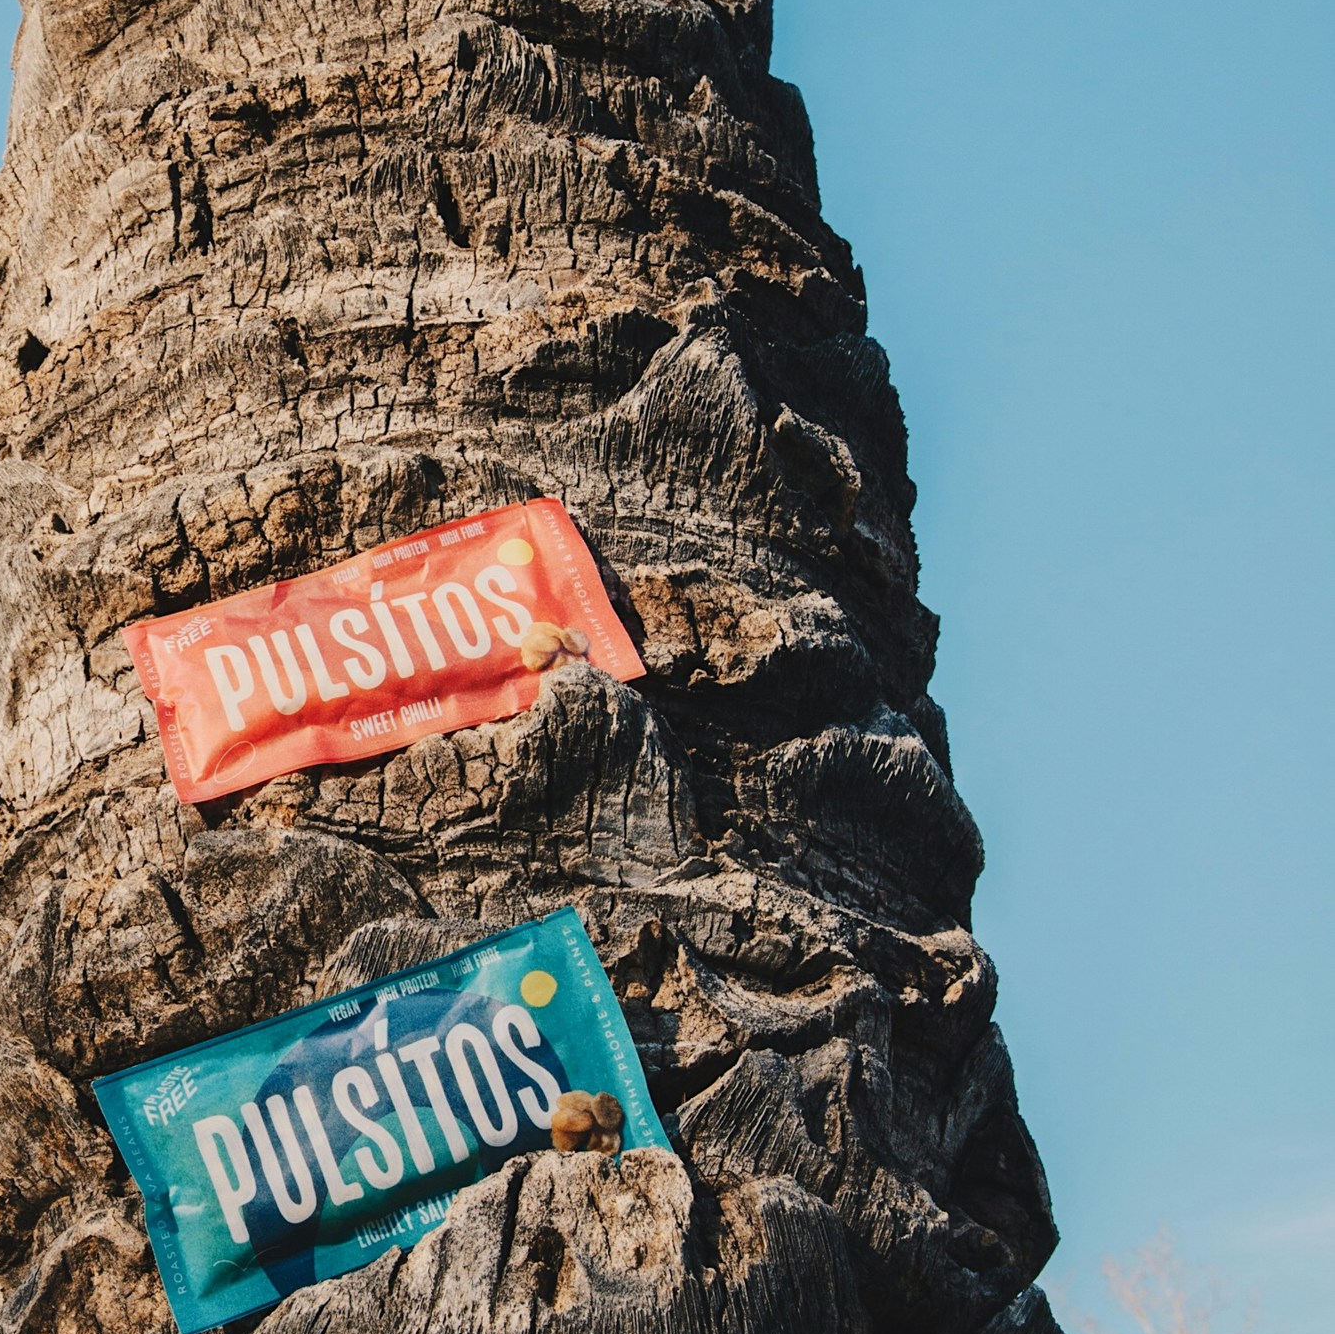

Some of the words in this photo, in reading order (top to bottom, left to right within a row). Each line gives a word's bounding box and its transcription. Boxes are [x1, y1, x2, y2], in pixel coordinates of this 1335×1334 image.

[438, 530, 462, 547] HIGH
[460, 521, 487, 540] FIBRE
[541, 509, 567, 551] PLANET
[371, 551, 394, 568] HIGH
[393, 539, 430, 562] PROTEIN
[562, 553, 573, 562] &
[331, 565, 361, 586] VEGAN
[568, 566, 594, 614] PEOPLE
[163, 620, 213, 654] FREE
[204, 565, 533, 732] PULSÍTOS
[588, 618, 619, 667] HEALTHY
[139, 652, 162, 689] BEANS
[350, 710, 398, 741] SWEET
[400, 696, 443, 726] CHILLI
[168, 723, 189, 779] ROASTED
[450, 961, 474, 978] HIGH
[473, 945, 502, 968] FIBRE
[562, 926, 594, 987] PLANET
[374, 985, 400, 1005] HIGH
[399, 971, 440, 997] PROTEIN
[591, 993, 602, 1003] &
[328, 999, 362, 1023] VEGAN
[597, 1010, 628, 1071] PEOPLE
[143, 1070, 198, 1126] FREE
[144, 1065, 188, 1105] PLASTIC
[192, 1004, 562, 1245] PULSÍTOS
[623, 1078, 657, 1147] HEALTHY
[118, 1116, 145, 1166] BEANS
[145, 1173, 164, 1211] FAVA
[354, 1207, 414, 1248] LIGHTLY
[157, 1220, 187, 1295] ROASTED
